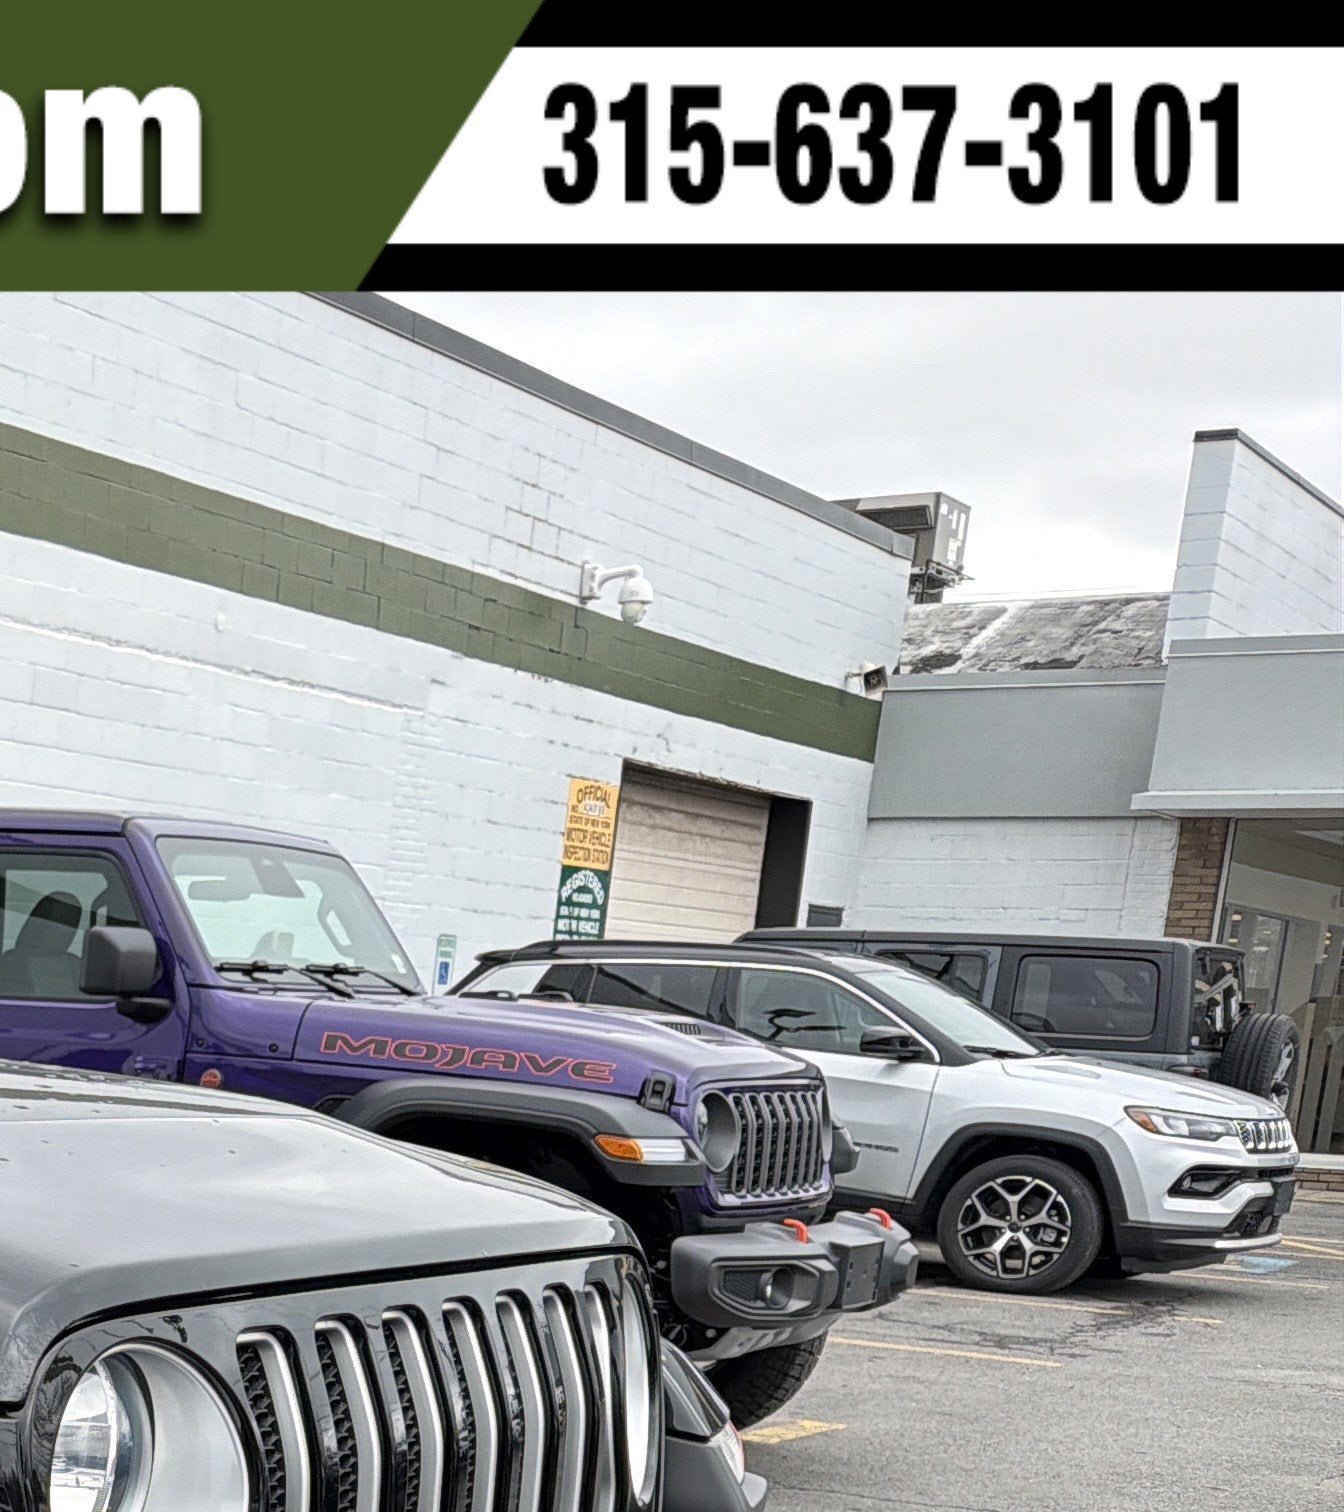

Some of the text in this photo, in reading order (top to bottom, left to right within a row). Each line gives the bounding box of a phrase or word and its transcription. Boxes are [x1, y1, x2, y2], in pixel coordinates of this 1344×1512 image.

[576, 784, 611, 809] OFFICIAL
[566, 827, 612, 848] MOTOR VEHICLE
[560, 869, 605, 906] REGISTERED
[319, 1031, 617, 1084] MOJAVE
